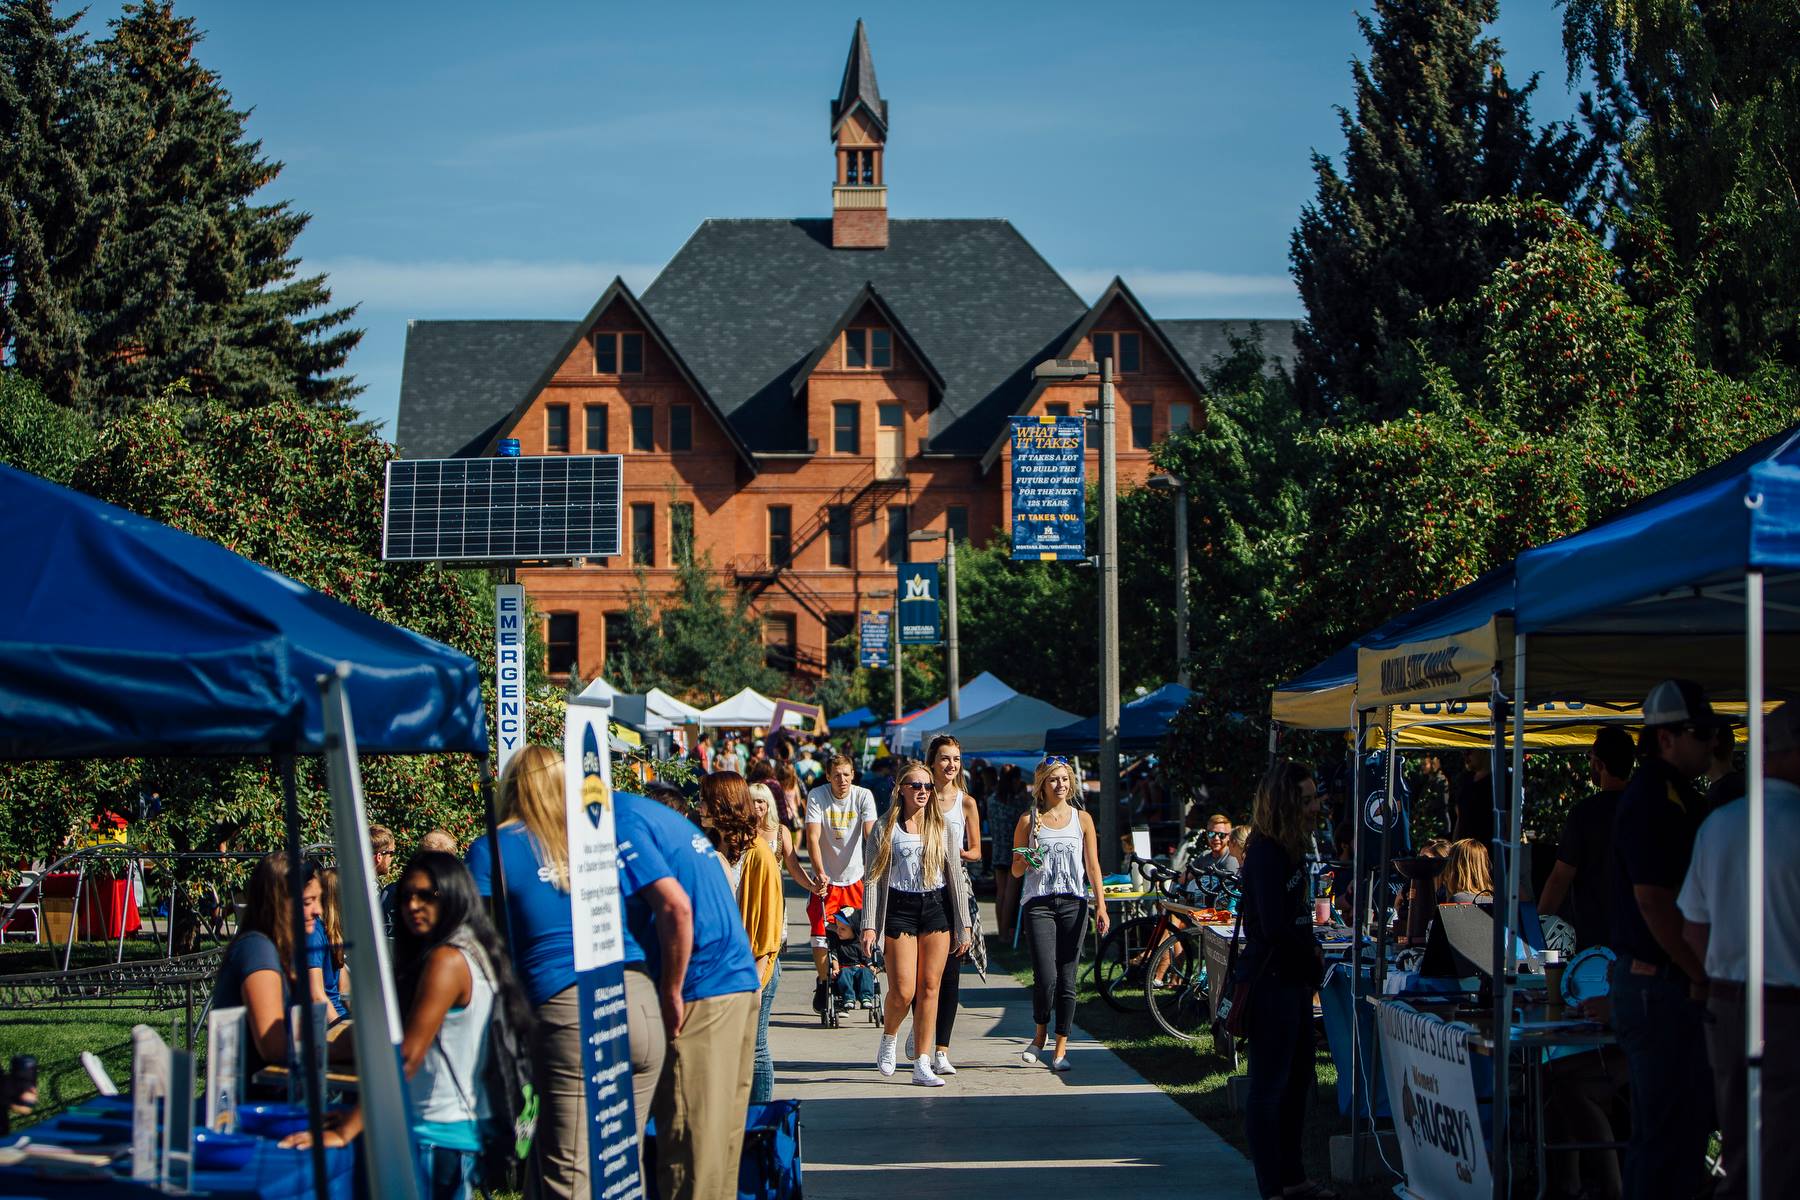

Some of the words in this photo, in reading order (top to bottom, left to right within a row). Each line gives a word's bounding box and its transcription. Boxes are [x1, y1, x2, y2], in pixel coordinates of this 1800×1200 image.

[1016, 426, 1057, 438] WHAT
[1015, 437, 1033, 449] IT
[1035, 437, 1079, 449] TAKES
[1020, 465, 1032, 473] TO
[1032, 465, 1058, 473] BUILD
[1058, 465, 1076, 473] THE
[1015, 476, 1050, 484] FUTURE
[1050, 476, 1062, 484] OF
[1062, 476, 1081, 484] MSU
[1019, 488, 1036, 496] FOR
[1036, 488, 1055, 496] THE
[1055, 488, 1078, 496] NEXT
[1017, 513, 1026, 521] IT
[1028, 513, 1056, 521] TAKES
[1058, 513, 1080, 521] YOU.
[500, 597, 518, 750] EMERGENCY
[1429, 1020, 1468, 1066] STATE
[1415, 1092, 1469, 1162] RUGBY
